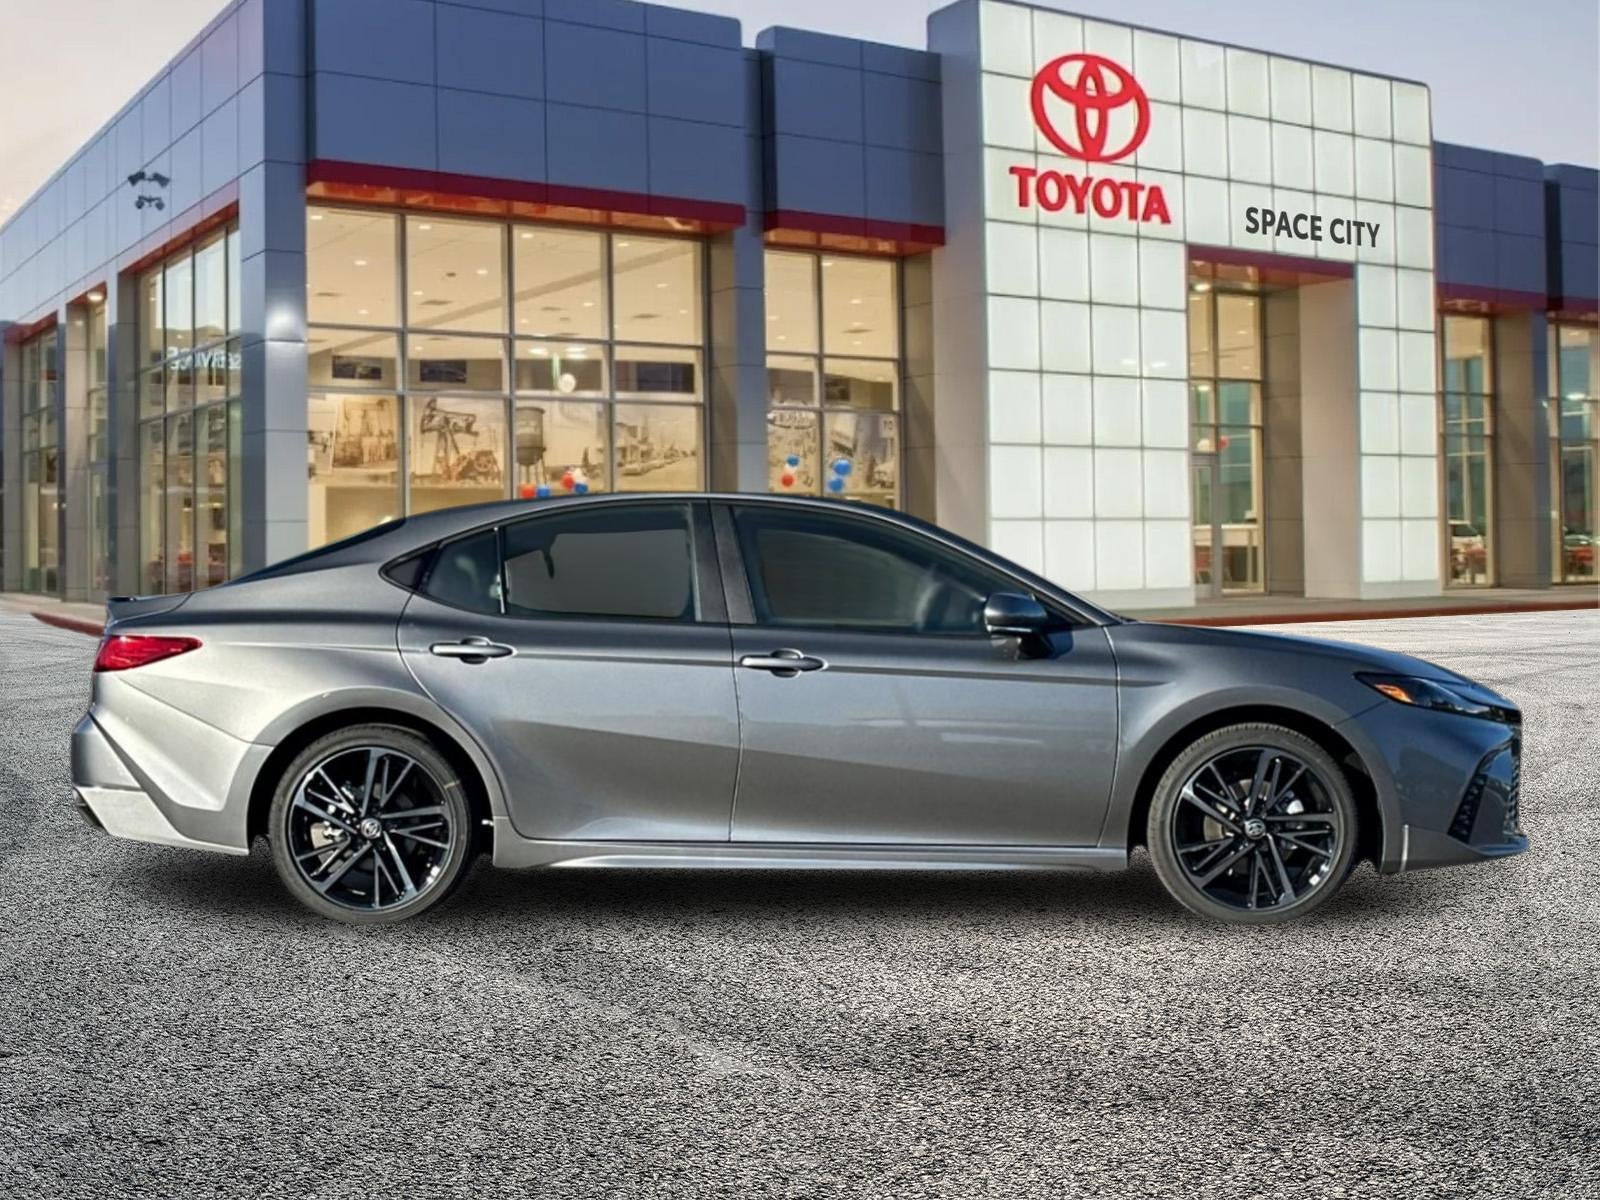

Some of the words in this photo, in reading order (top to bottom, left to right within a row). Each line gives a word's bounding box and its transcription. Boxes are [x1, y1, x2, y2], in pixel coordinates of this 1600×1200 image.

[1009, 166, 1171, 225] TOYOTA
[1245, 206, 1323, 241] SPACE
[1329, 218, 1381, 248] CITY
